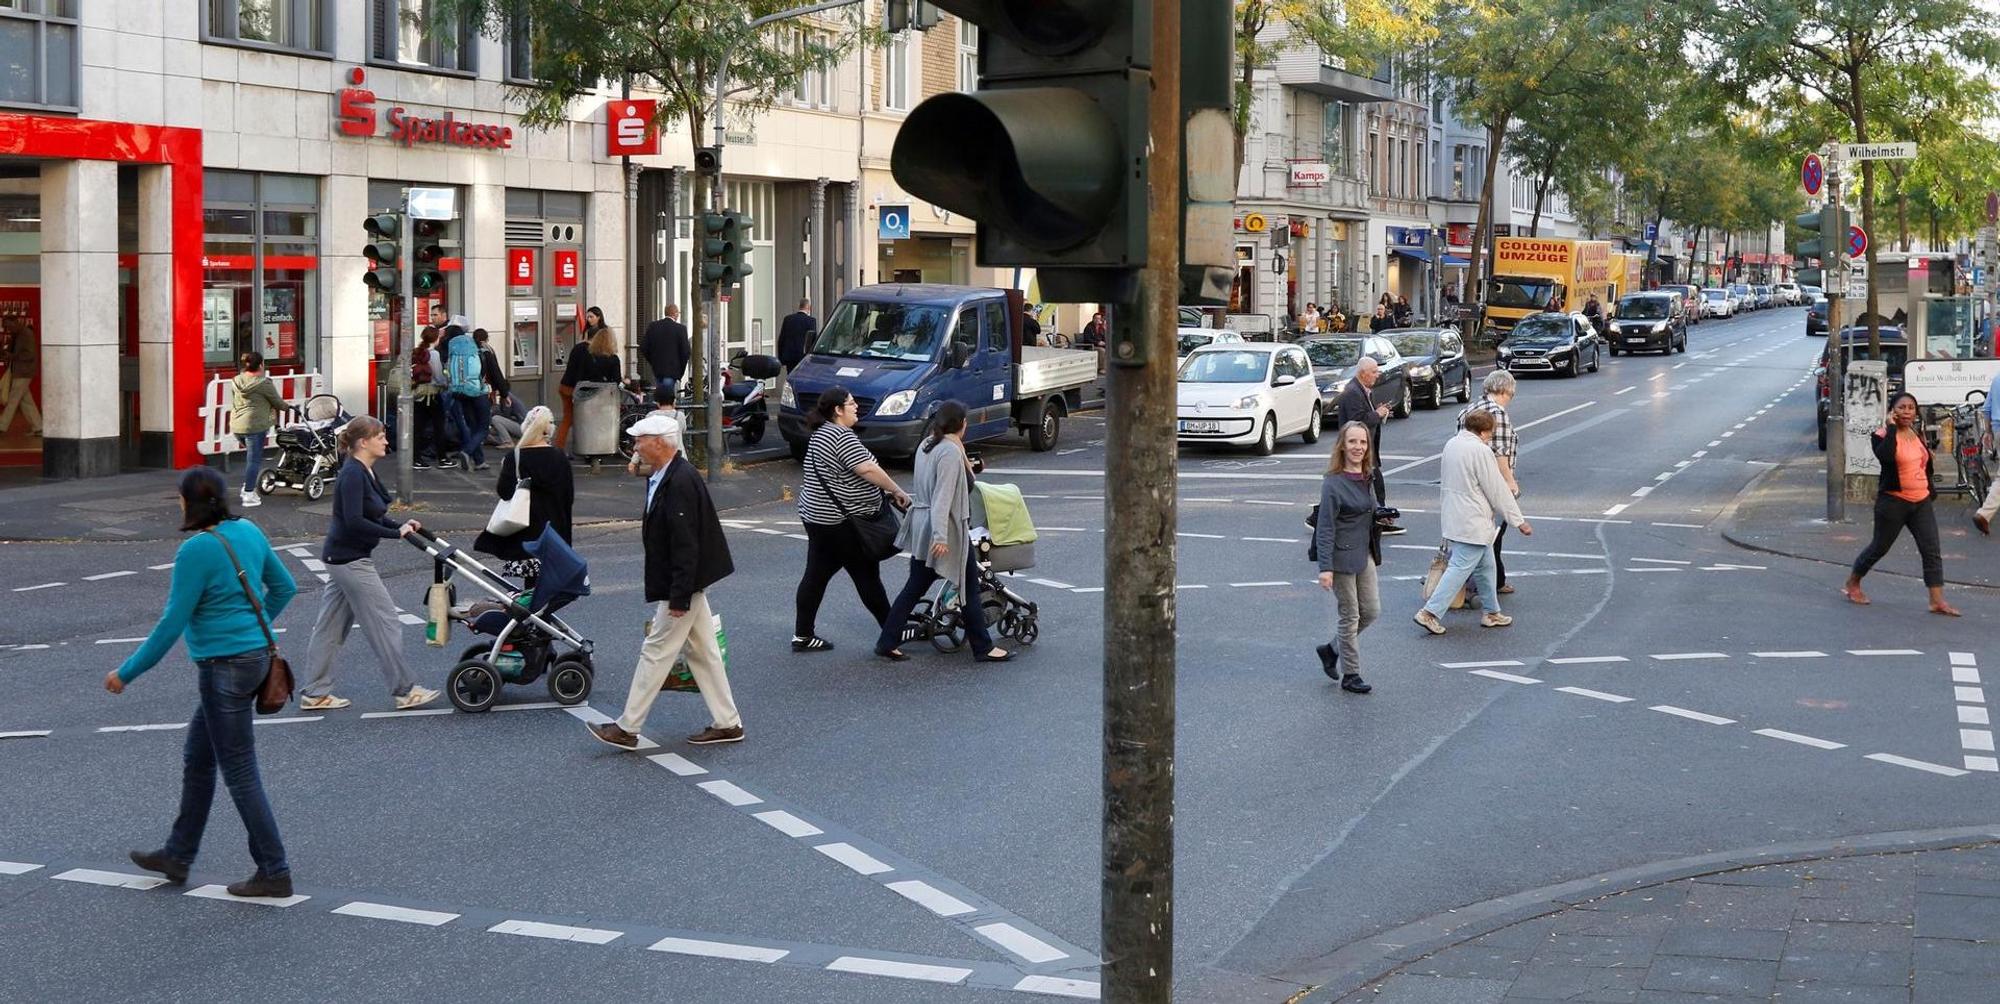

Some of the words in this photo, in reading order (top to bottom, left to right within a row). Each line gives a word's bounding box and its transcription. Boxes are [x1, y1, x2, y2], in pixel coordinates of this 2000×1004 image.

[388, 107, 513, 149] Sparkasse
[1294, 171, 1325, 181] Kamps
[1500, 241, 1568, 252] COLONIA
[1585, 243, 1608, 261] COLONIA
[1500, 251, 1568, 263] UMZÜGE
